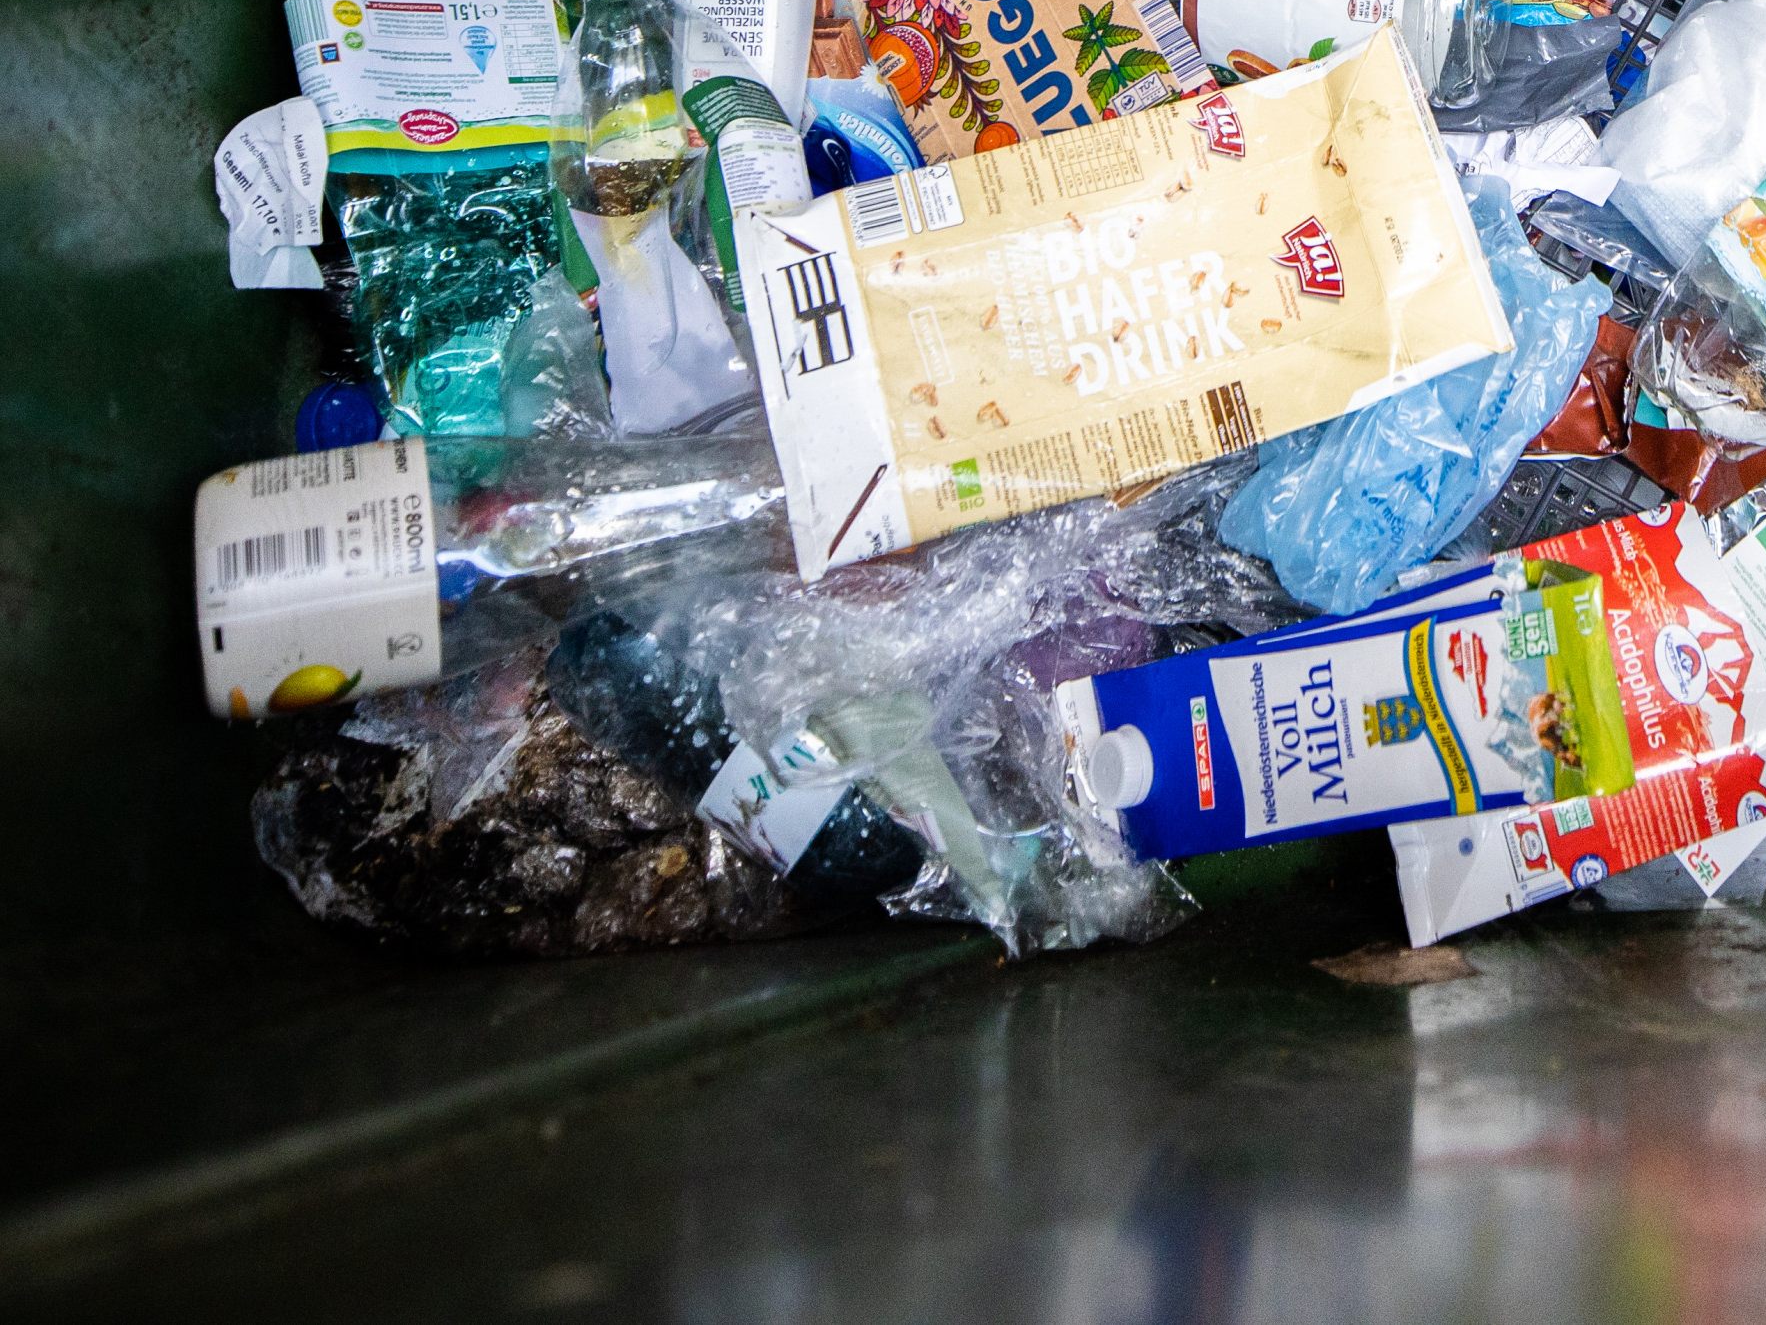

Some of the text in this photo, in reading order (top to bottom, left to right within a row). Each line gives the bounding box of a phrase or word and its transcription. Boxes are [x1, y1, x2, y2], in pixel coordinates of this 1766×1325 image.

[448, 2, 480, 20] 1,5L
[1209, 100, 1244, 146] ja!
[221, 149, 280, 225] Gesamt 17,10
[1040, 213, 1144, 287] BIO
[1299, 229, 1344, 286] ja!
[1052, 247, 1232, 341] HAFER
[1067, 301, 1248, 395] DRINK
[1616, 530, 1638, 562] Milch
[1521, 611, 1546, 657] gen
[1411, 633, 1440, 721] Niederösterreich
[1604, 604, 1672, 751] Acidophilus
[1192, 724, 1213, 794] SPAR
[1247, 662, 1280, 825] Niederösterreichische
[1269, 700, 1305, 779] Voll
[1295, 659, 1348, 808] Milch
[1339, 698, 1354, 759] pasteurisiert
[1438, 734, 1470, 794] hergestellt
